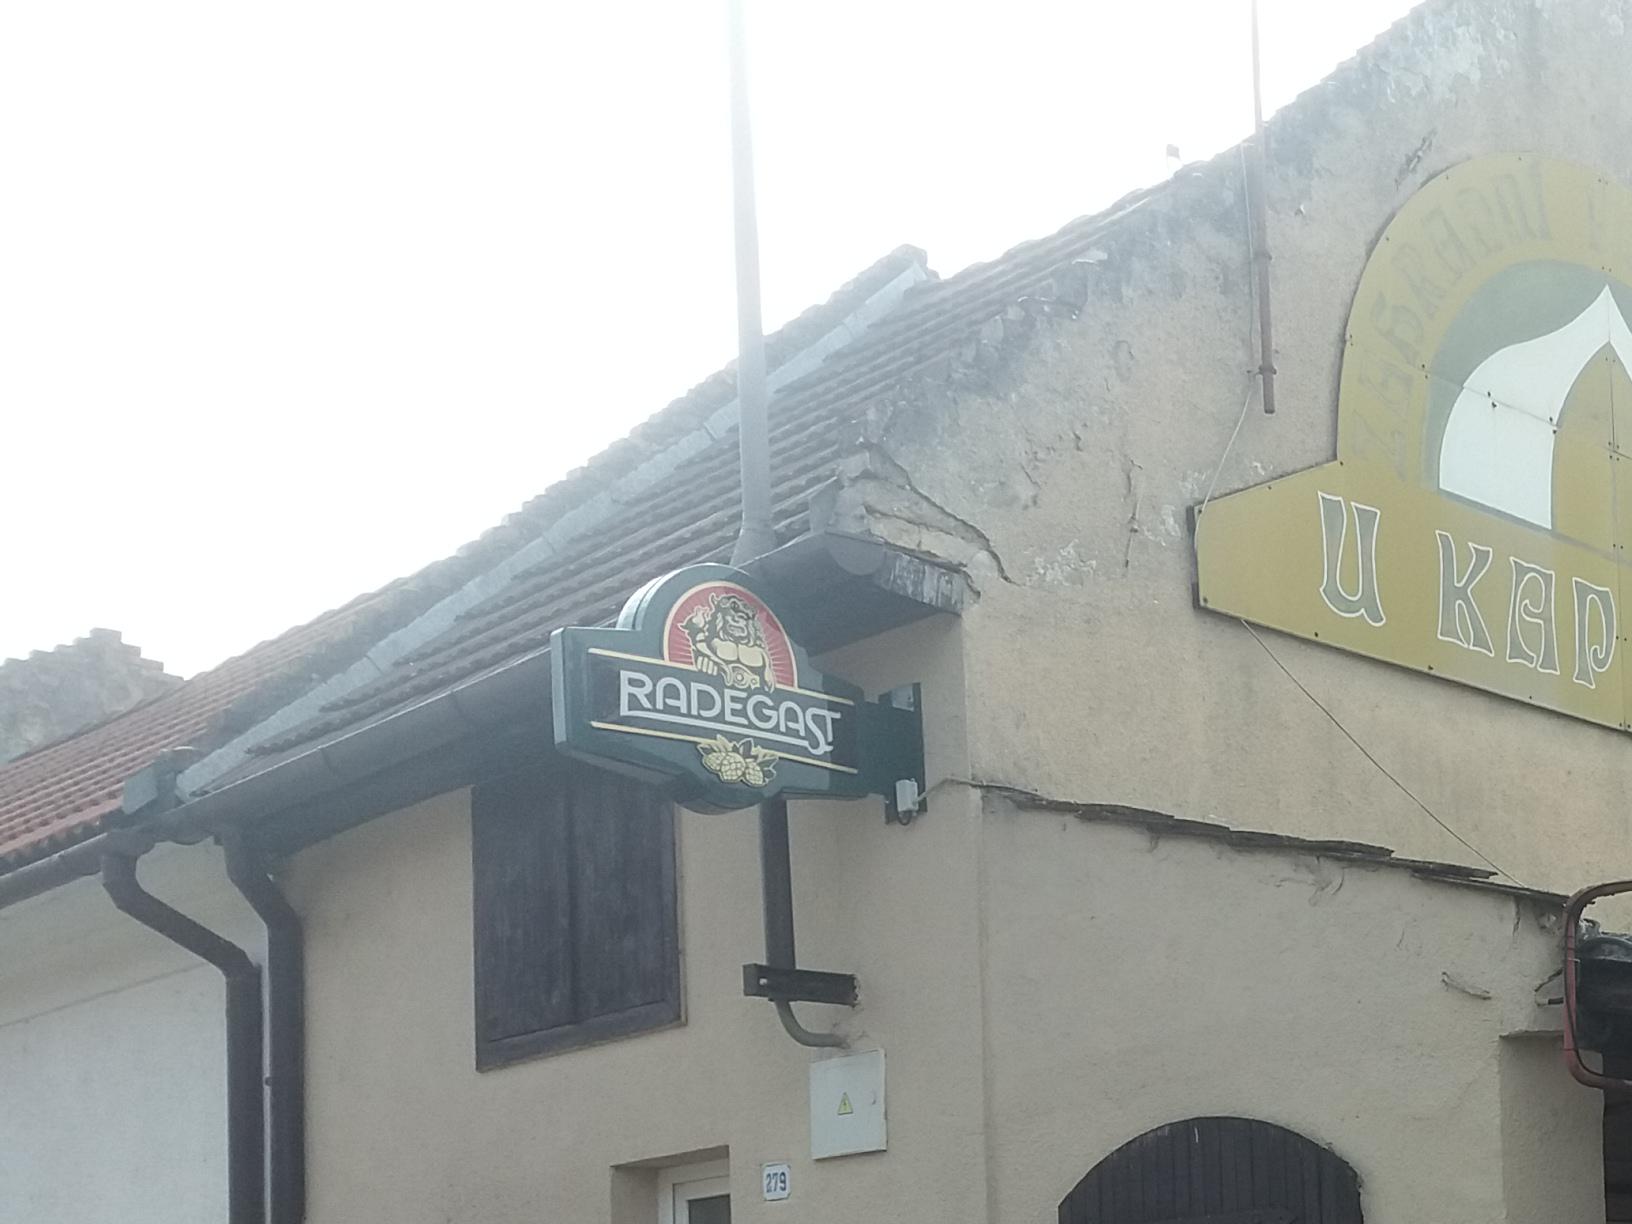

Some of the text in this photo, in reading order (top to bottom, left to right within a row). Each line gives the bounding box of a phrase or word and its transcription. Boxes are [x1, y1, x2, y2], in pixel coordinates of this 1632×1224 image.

[1316, 489, 1387, 628] U
[619, 669, 842, 756] RADEGAST
[766, 1171, 787, 1193] 279
